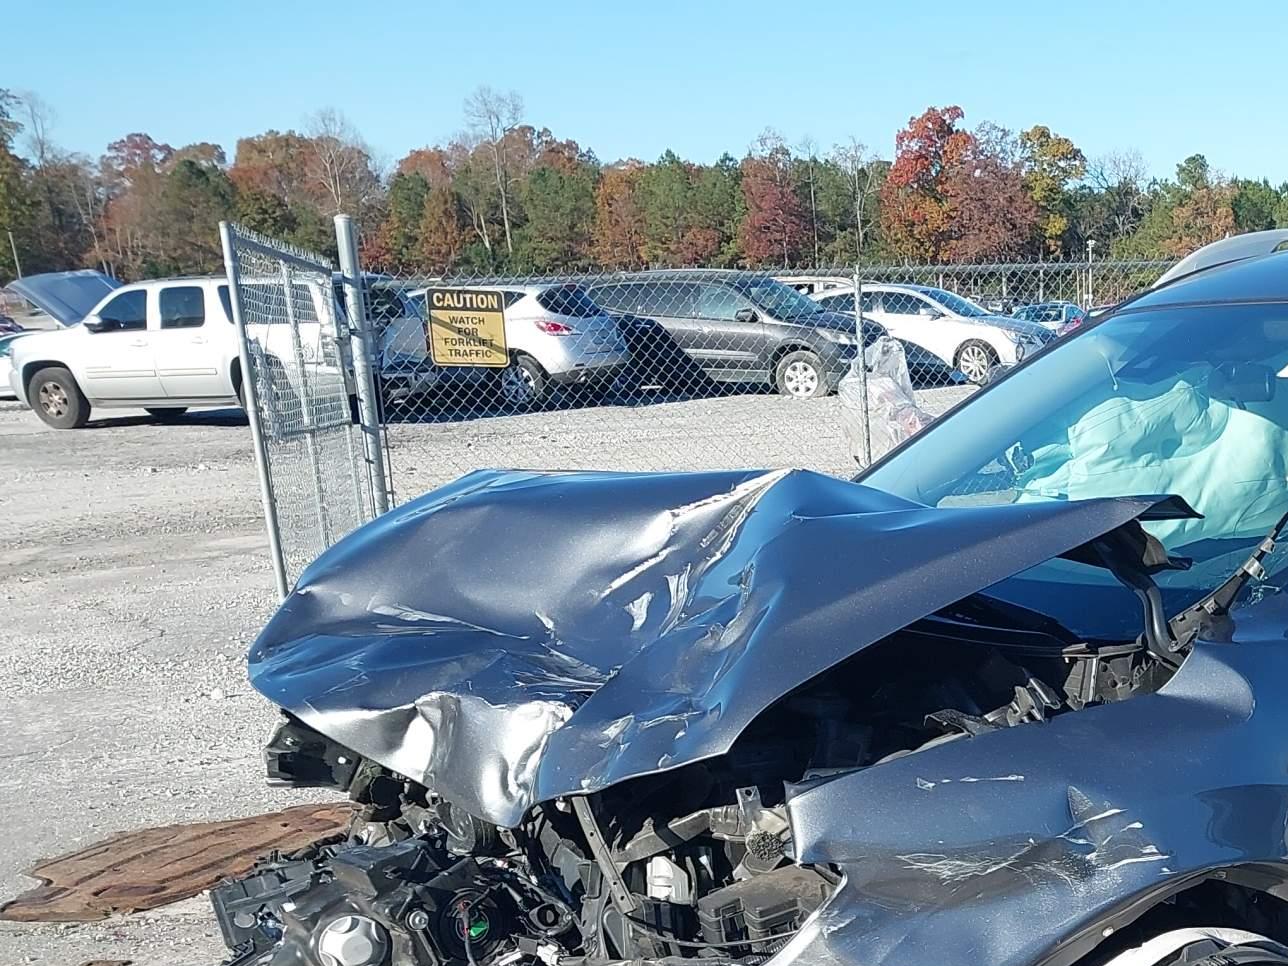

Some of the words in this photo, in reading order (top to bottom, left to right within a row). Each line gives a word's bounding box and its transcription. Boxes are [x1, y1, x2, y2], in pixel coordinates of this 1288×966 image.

[432, 292, 498, 309] CAUTION
[448, 315, 486, 326] WATCH
[457, 327, 479, 337] FOR
[444, 337, 495, 348] FORKLIFT
[448, 348, 493, 359] TRAFFIC
